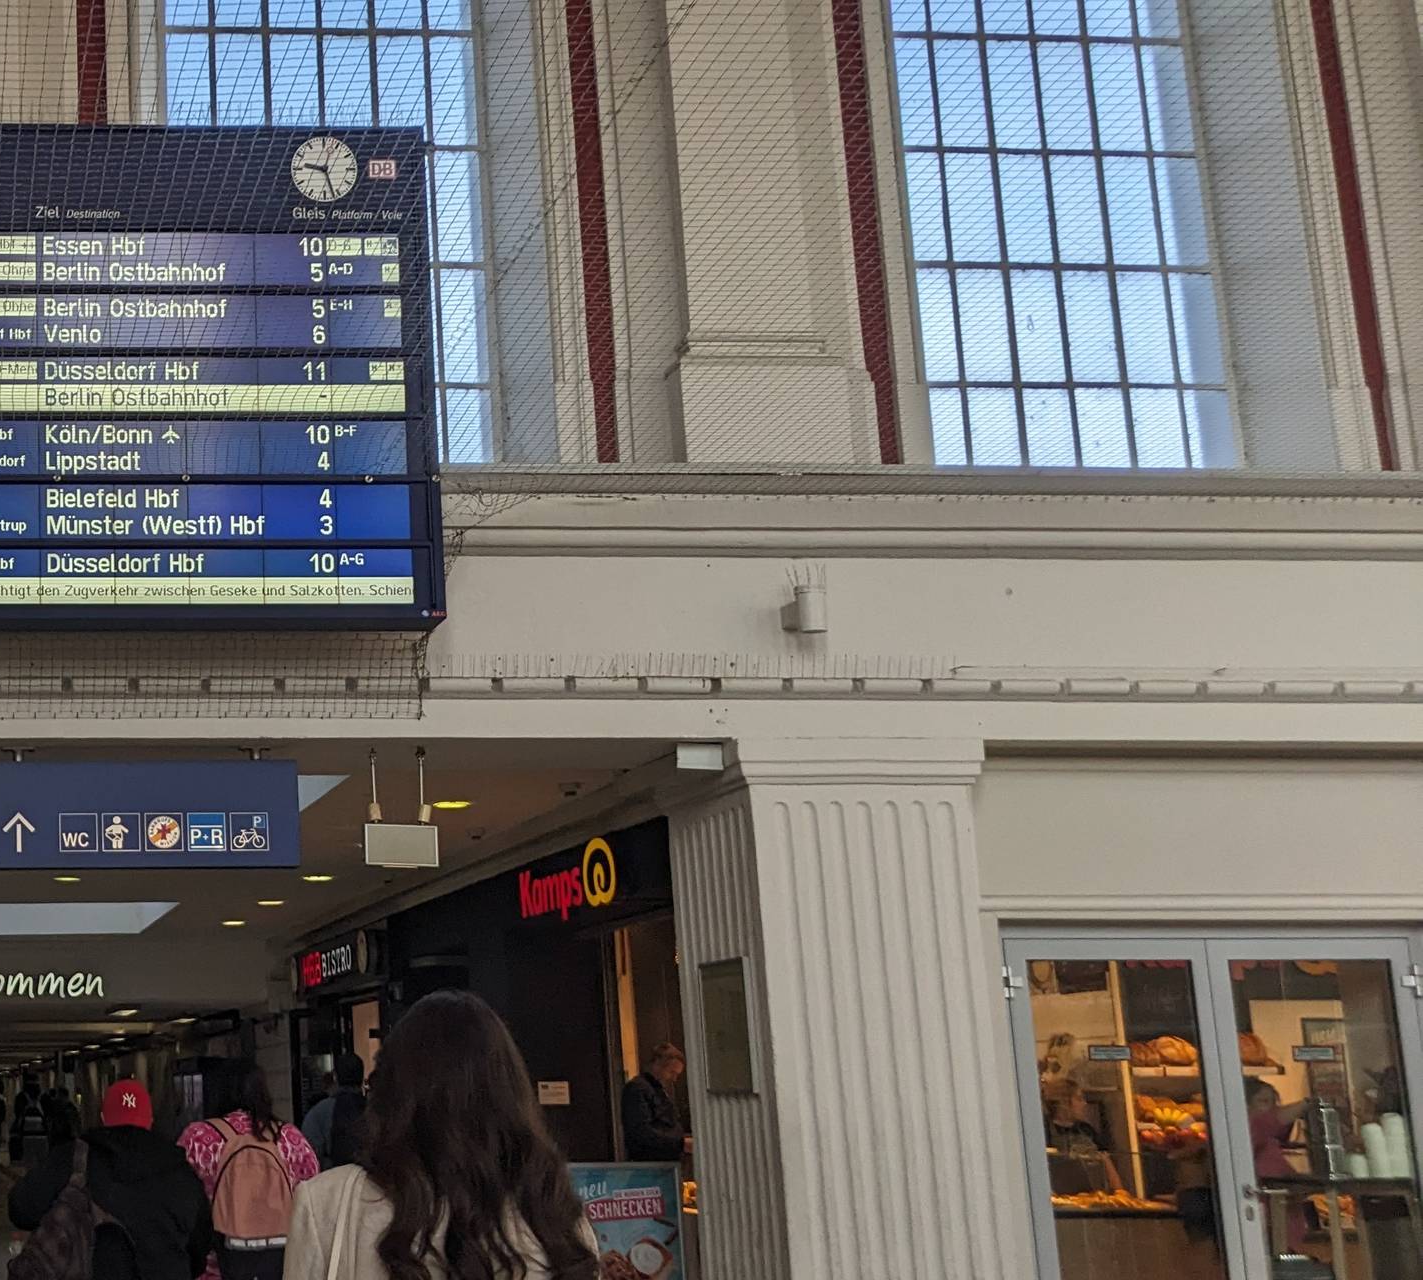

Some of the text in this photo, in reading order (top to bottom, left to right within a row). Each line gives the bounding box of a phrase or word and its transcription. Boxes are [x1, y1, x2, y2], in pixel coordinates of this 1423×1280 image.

[371, 162, 394, 177] DB
[35, 206, 120, 219] Ziel Destination
[292, 207, 402, 220] Gleis Platform Voie
[42, 237, 103, 256] Essen
[111, 236, 145, 256] Hbf
[298, 238, 323, 256] 10
[42, 263, 101, 282] Berlin
[109, 263, 225, 282] Ostbahnhof
[310, 263, 323, 282] 5
[328, 263, 353, 275] A-D
[43, 299, 101, 318] Berlin
[110, 298, 227, 318] Ostbahnhof
[312, 299, 325, 318] 5
[330, 299, 353, 311] E-H
[9, 328, 32, 340] Hbf
[45, 325, 101, 344] Venlo
[312, 325, 326, 344] 6
[44, 361, 156, 380] Düsseldorf
[164, 361, 200, 380] Hbf
[302, 362, 326, 380] 11
[45, 388, 102, 406] Berlin
[111, 388, 228, 406] Ostbahnhof
[45, 425, 153, 445] Köln/Bonn
[304, 425, 329, 444] 10
[335, 425, 358, 437] B-F
[45, 451, 141, 474] Lippstadt
[317, 452, 330, 471] 4
[46, 489, 137, 509] Bielefeld
[145, 489, 180, 509] Hbf
[319, 489, 333, 509] 4
[46, 515, 134, 535] Münster
[142, 515, 222, 537] (Westf)
[230, 515, 265, 535] Hbf
[319, 515, 333, 535] 3
[47, 553, 161, 573] Düsseldorf
[169, 553, 205, 573] Hbf
[309, 553, 335, 573] 10
[339, 553, 365, 566] A-G
[36, 584, 60, 597] den
[64, 584, 138, 599] Zugverkehr
[143, 584, 206, 597] zwischen
[209, 584, 257, 597] Geseke
[262, 584, 286, 597] und
[290, 584, 366, 597] Salzkotten.
[253, 816, 262, 825] P
[62, 832, 89, 848] WC
[191, 829, 224, 845] P+R
[519, 866, 583, 921] Kamps
[321, 944, 352, 978] BISTRO
[589, 1198, 662, 1220] SCHNECKEN
